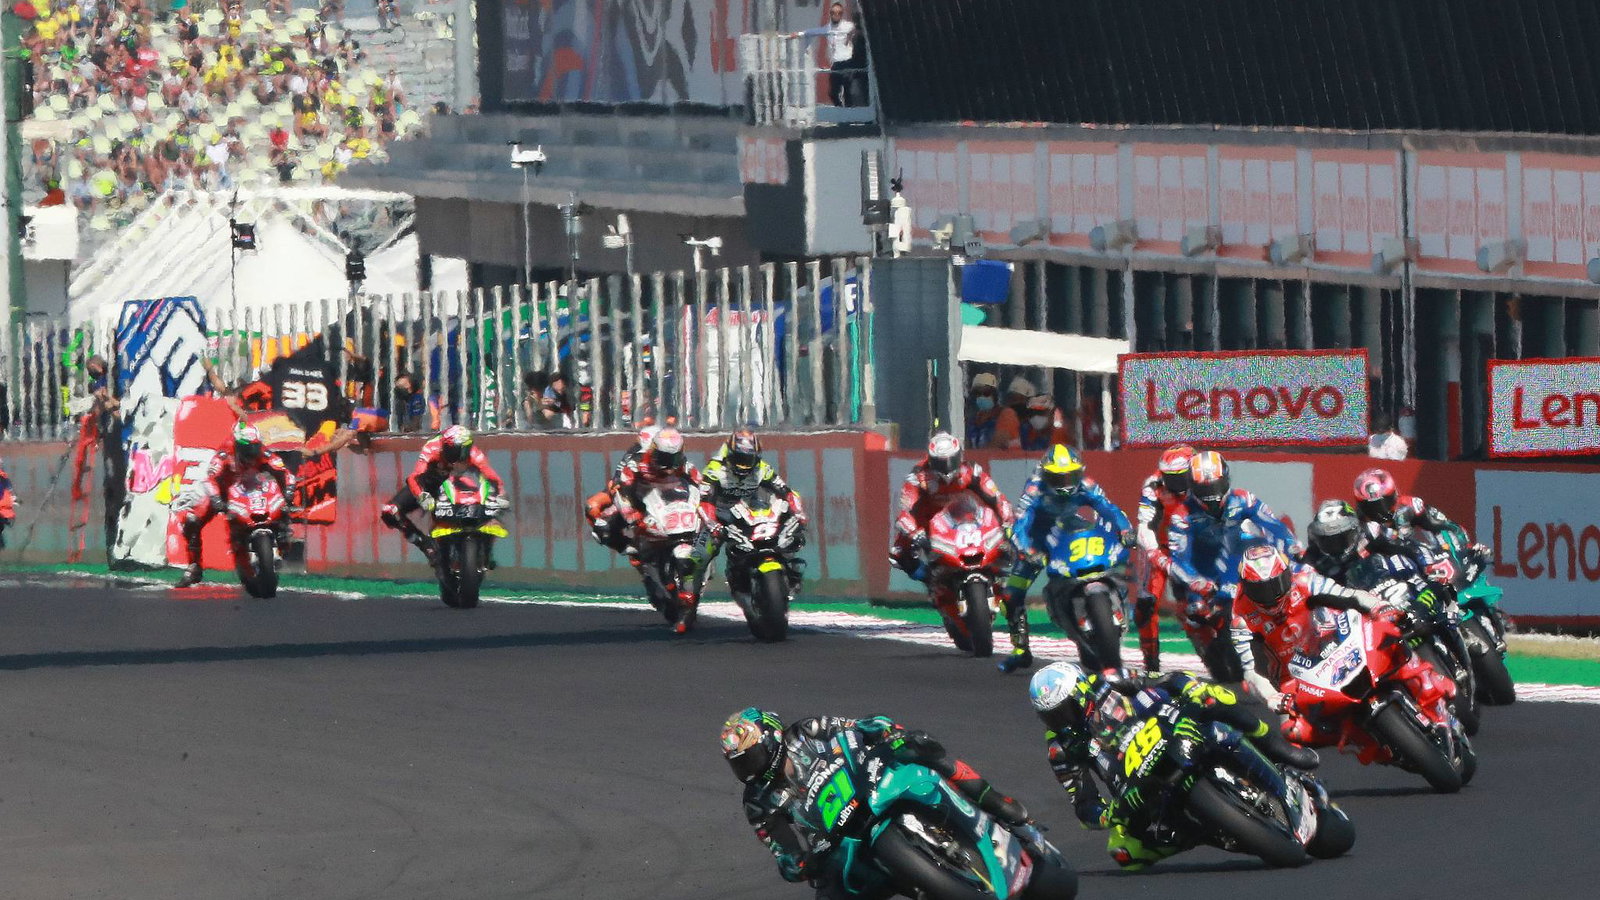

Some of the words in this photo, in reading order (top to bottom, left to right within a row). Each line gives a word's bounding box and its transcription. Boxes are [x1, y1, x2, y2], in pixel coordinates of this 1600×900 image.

[281, 381, 328, 411] 33
[1145, 379, 1344, 422] Lenovo
[1513, 387, 1600, 429] Len
[1069, 536, 1105, 563] 36
[1492, 505, 1600, 582] Leno
[1124, 717, 1162, 778] 46
[804, 757, 845, 812] PETRONAS
